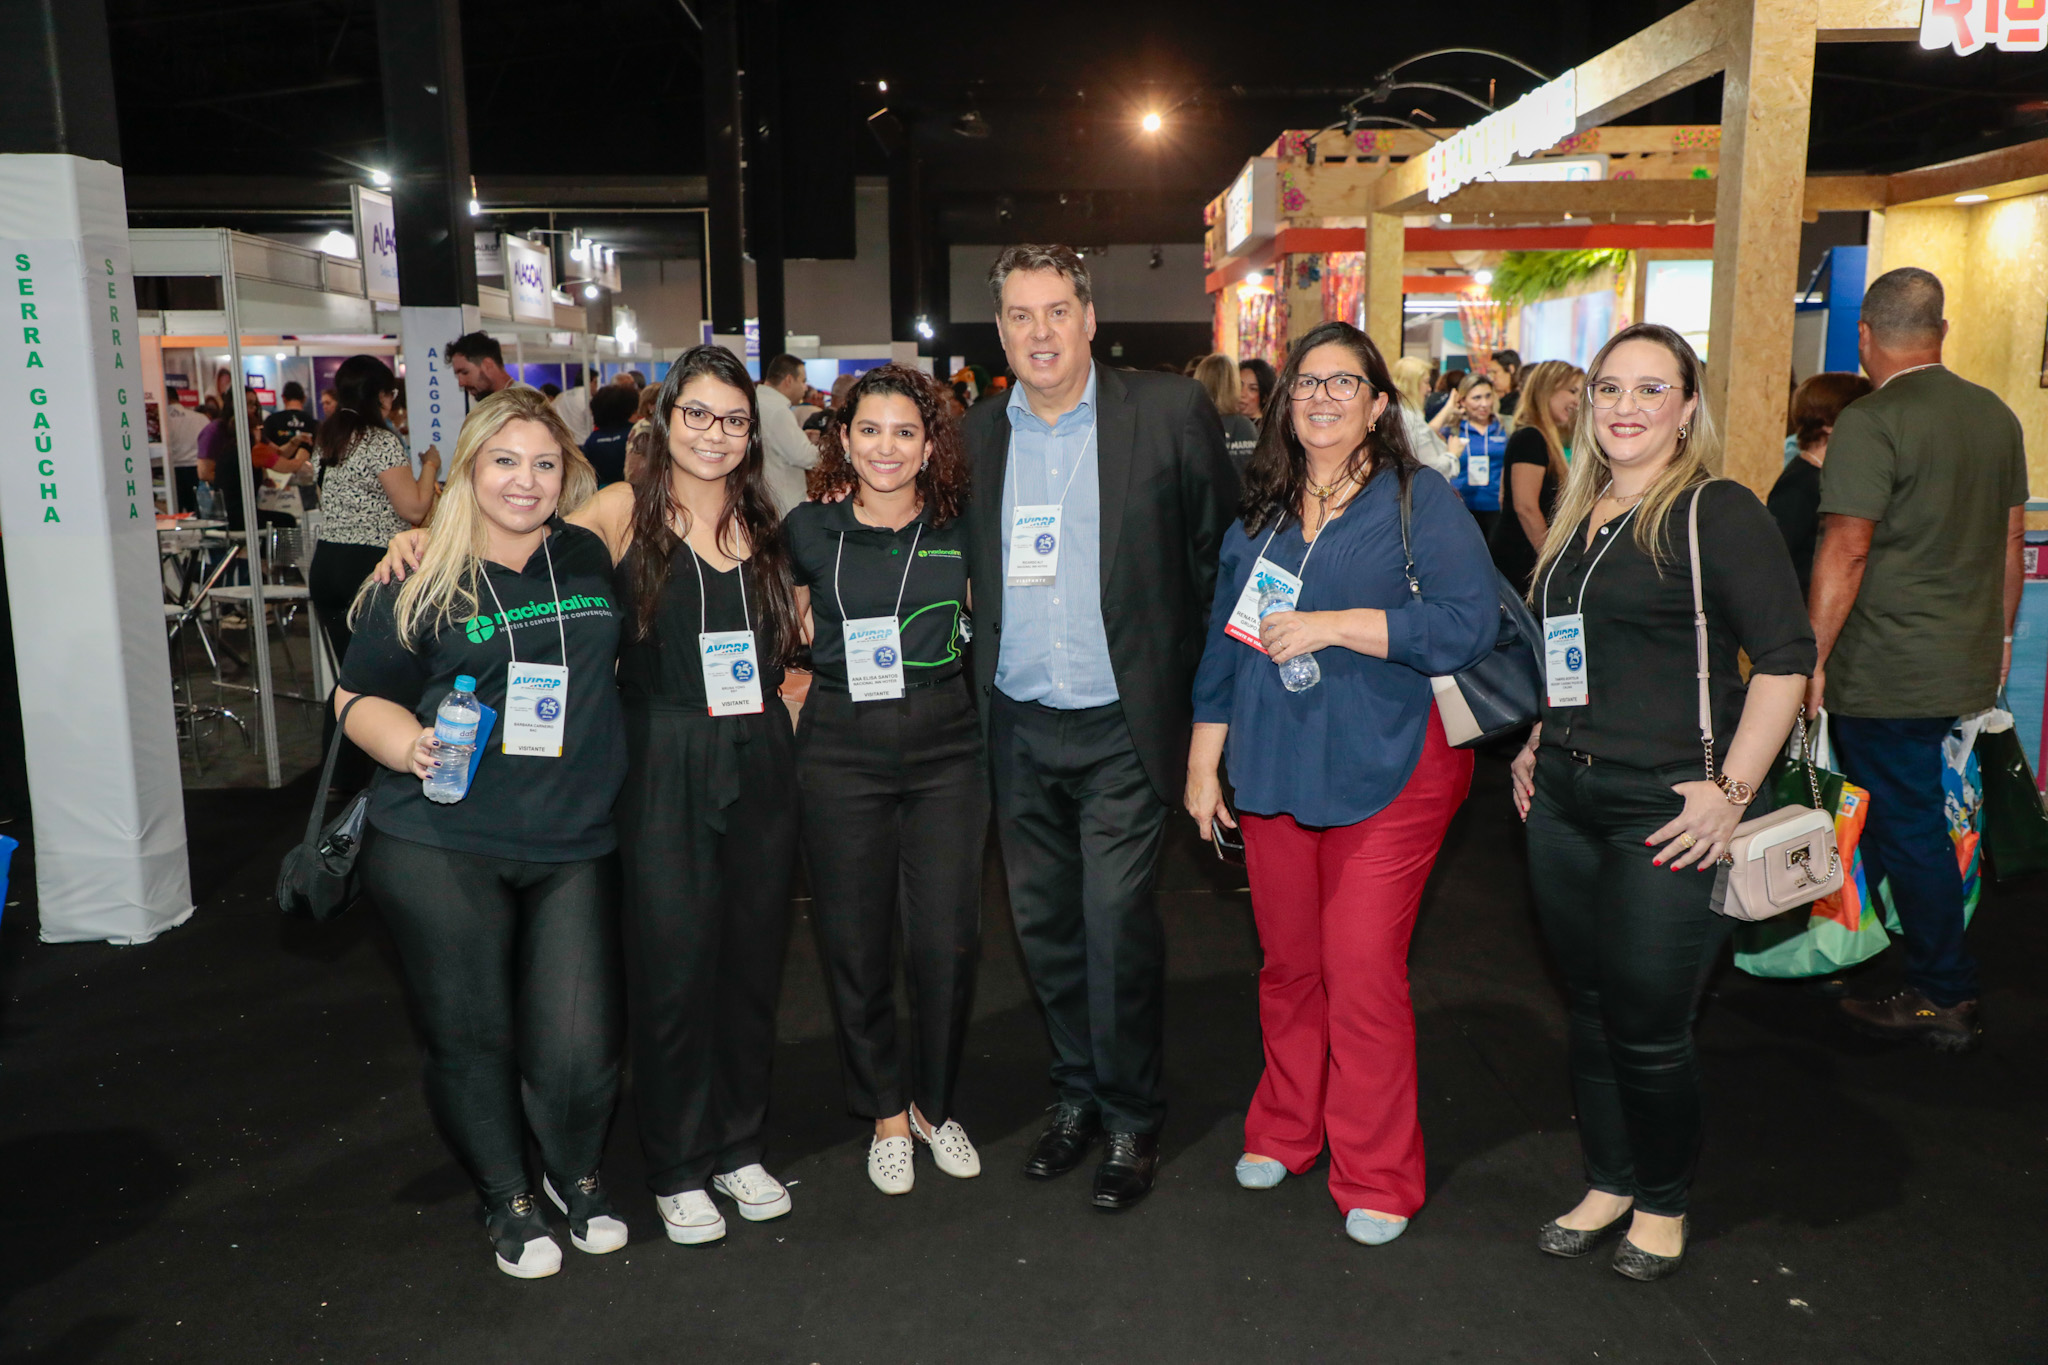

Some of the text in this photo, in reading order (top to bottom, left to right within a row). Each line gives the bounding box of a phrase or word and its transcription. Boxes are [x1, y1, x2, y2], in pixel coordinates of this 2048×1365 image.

[514, 259, 544, 293] ALAGOAS
[15, 253, 61, 523] SERRA GAÚCHA
[104, 258, 138, 519] SERRA GAÚCHA
[427, 347, 442, 443] ALAGOAS
[1015, 516, 1056, 527] AVIRRP
[1038, 536, 1053, 550] 25
[494, 594, 610, 625] nacionalinn
[529, 616, 559, 626] CENTROS
[1236, 610, 1257, 624] RENATA
[847, 629, 893, 641] AVIRRP
[1548, 627, 1580, 641] AVIRRP
[705, 642, 750, 654] AVIRRP
[878, 649, 893, 663] 25
[1568, 650, 1580, 665] 25
[735, 662, 751, 677] 25
[512, 676, 561, 689] AVIRRP
[539, 700, 557, 716] 25
[721, 699, 750, 707] VISITANTE
[518, 745, 545, 753] VISITANTE
